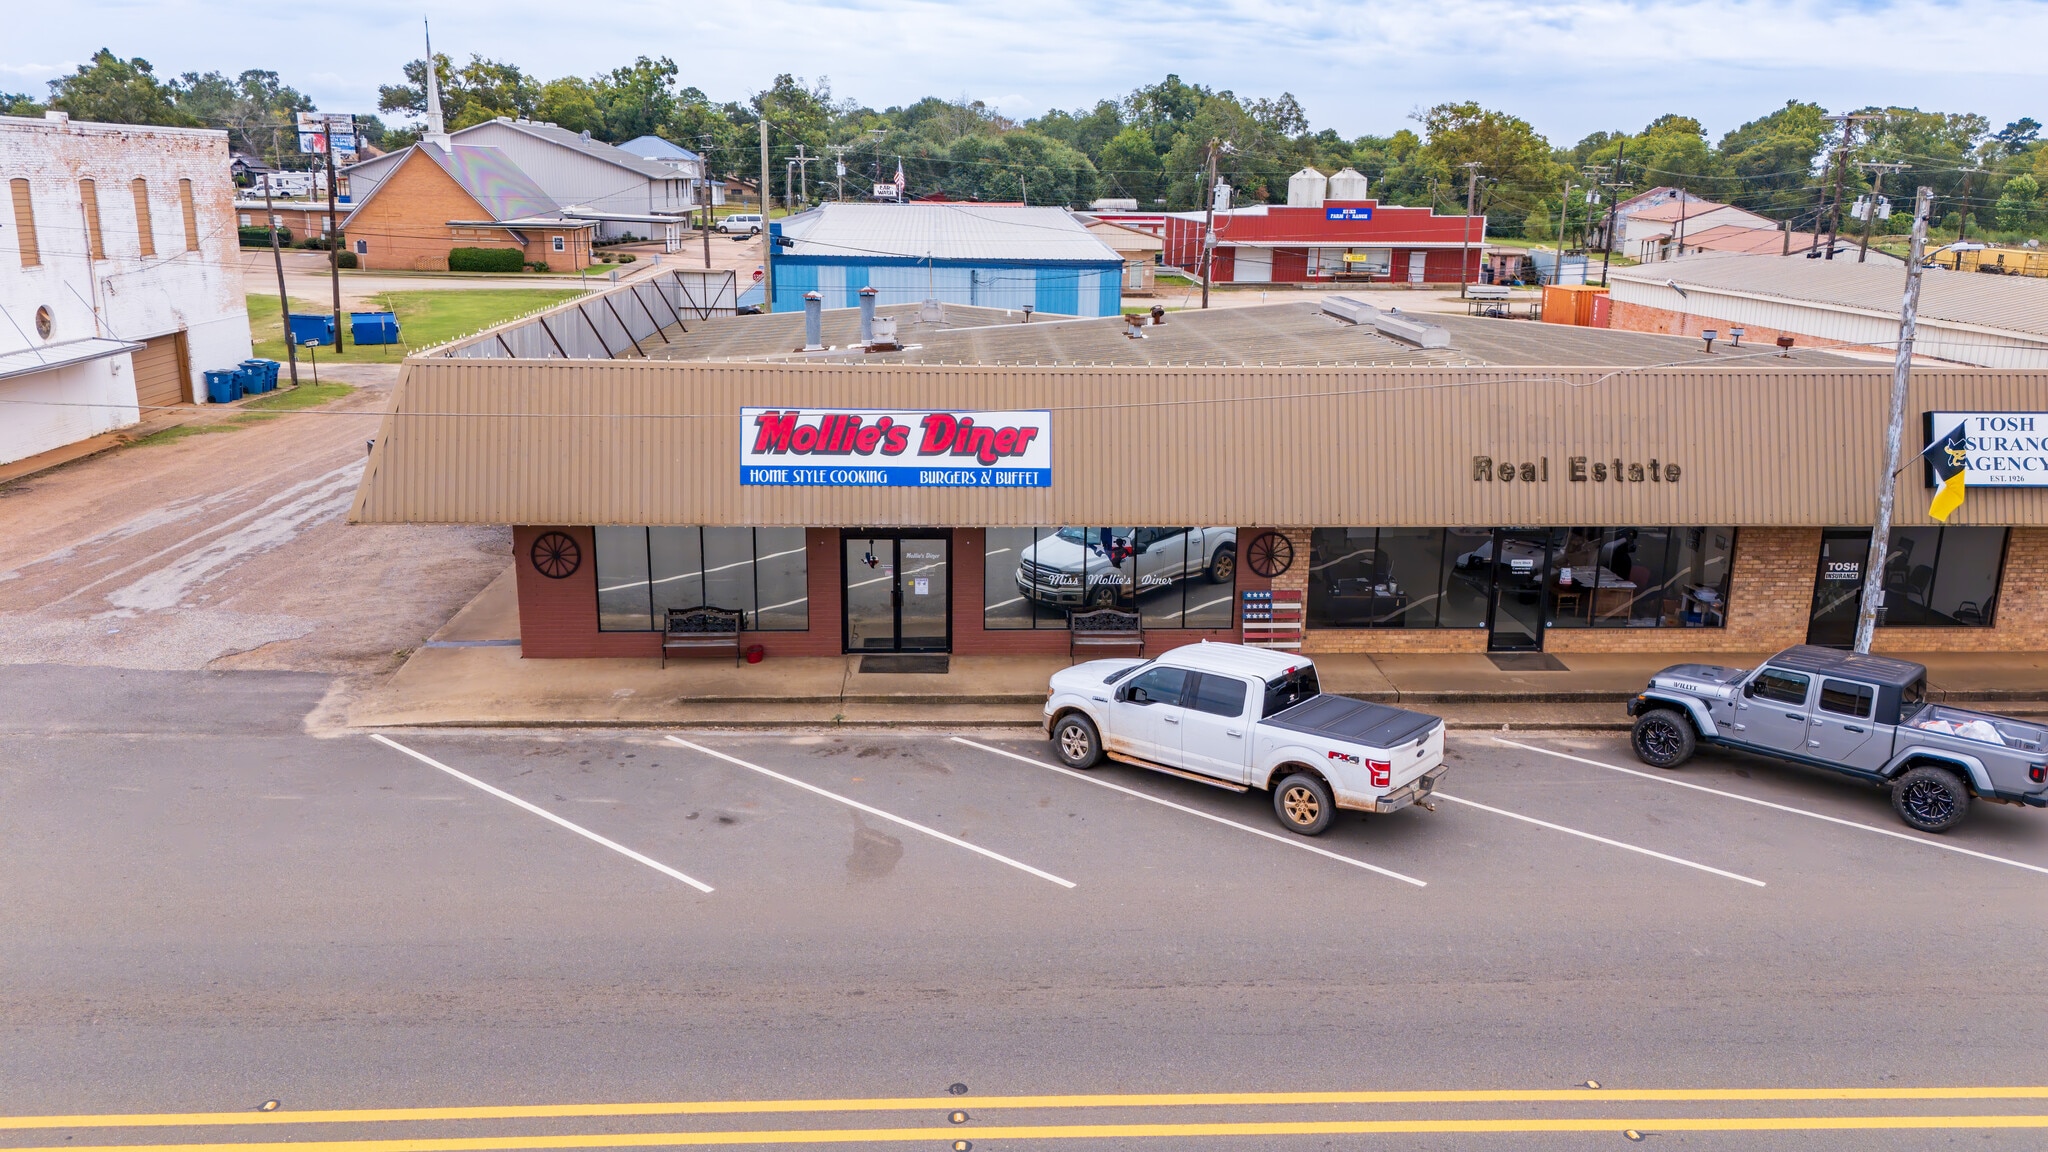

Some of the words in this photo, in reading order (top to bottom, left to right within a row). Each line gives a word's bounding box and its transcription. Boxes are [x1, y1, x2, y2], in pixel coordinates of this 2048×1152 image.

[1975, 417, 2035, 432] TOSH
[751, 410, 911, 456] Mollie's
[917, 413, 1039, 466] Diner
[750, 469, 789, 483] HOME
[792, 469, 828, 483] STYLE
[829, 470, 888, 484] COOKING
[1473, 456, 1548, 482] Real
[1568, 456, 1682, 482] Estate
[920, 470, 977, 484] BURGERS
[980, 469, 992, 485] &
[995, 471, 1039, 485] BUFFET
[1828, 562, 1859, 571] TOSH
[1048, 574, 1079, 585] Miss
[1087, 574, 1131, 585] Mollie's
[1141, 574, 1173, 585] Diner
[1673, 681, 1698, 691] WILLYS
[1328, 750, 1360, 765] FX4
